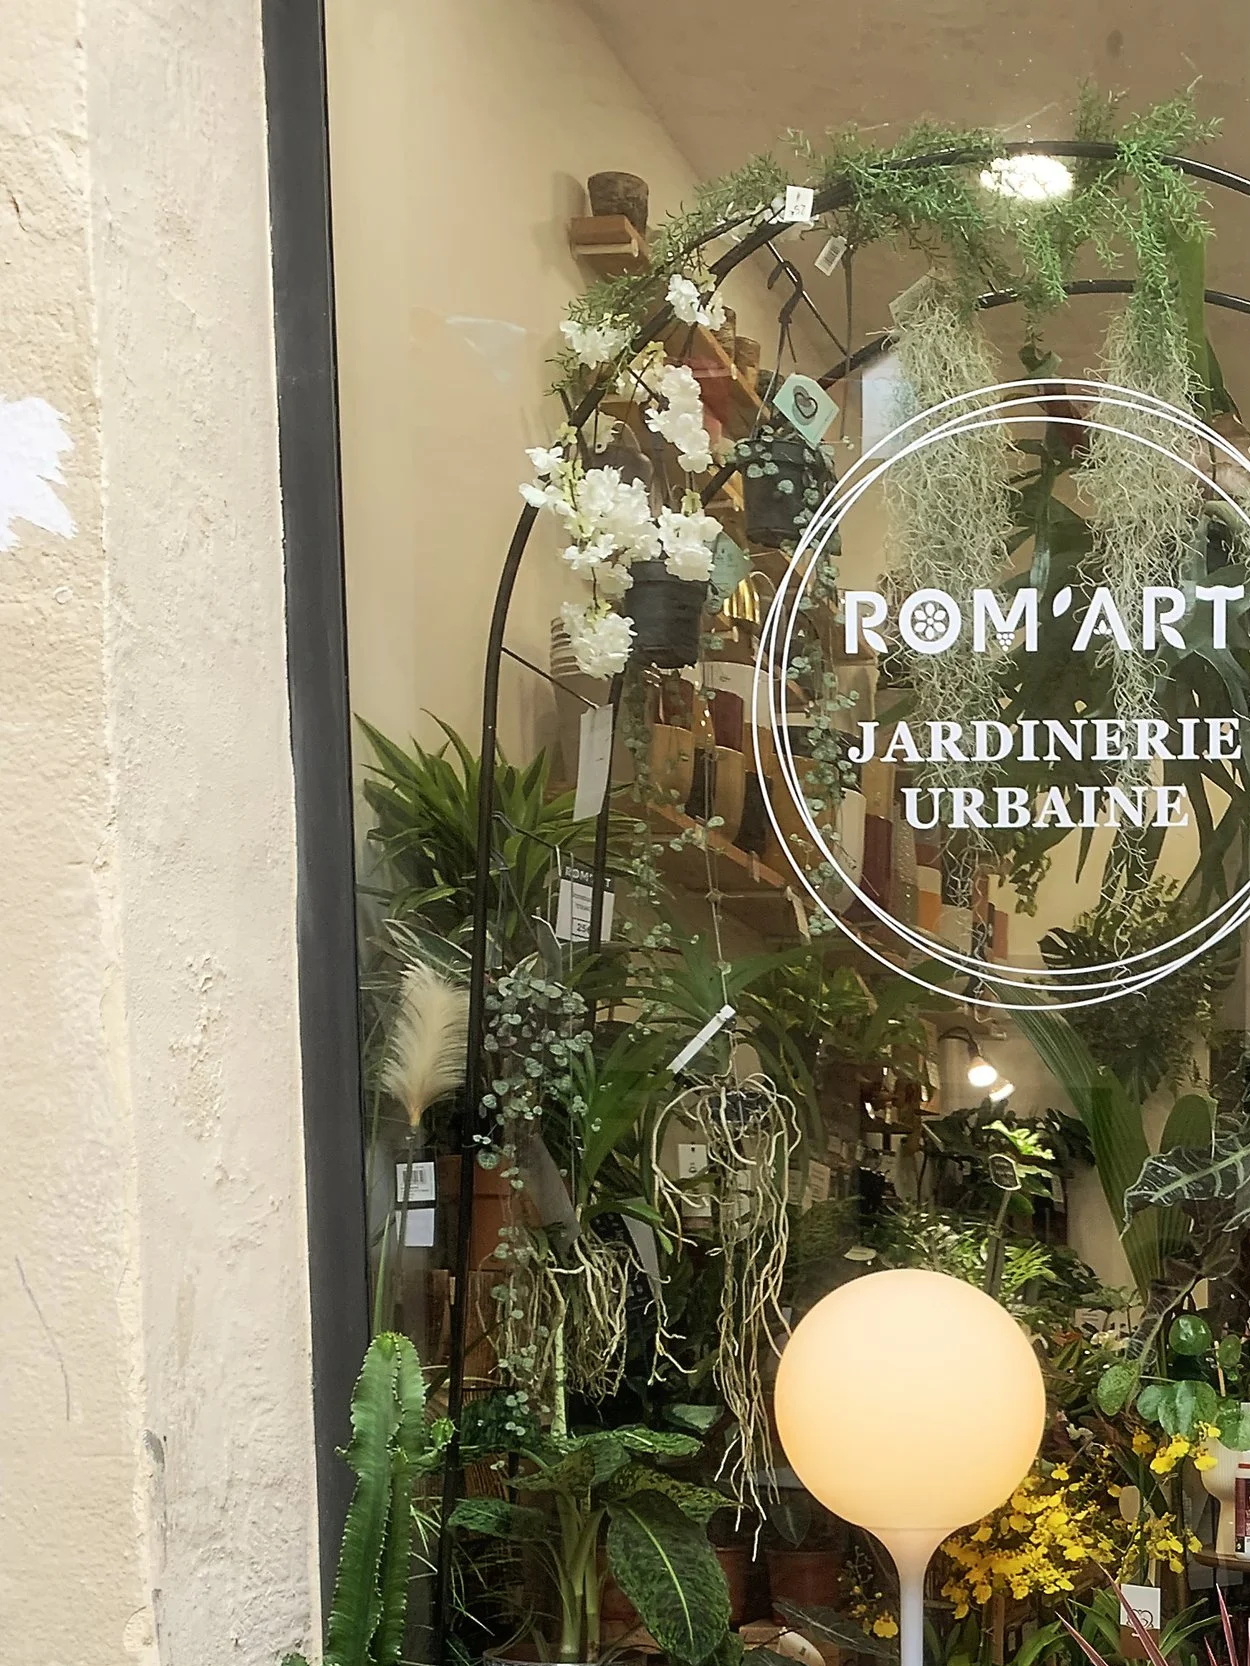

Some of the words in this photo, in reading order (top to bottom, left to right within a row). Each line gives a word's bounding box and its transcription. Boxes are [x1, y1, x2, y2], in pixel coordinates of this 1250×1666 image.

[843, 584, 1245, 654] ROM'ART
[847, 717, 1242, 764] JARDINERIE
[900, 784, 1189, 830] URBAINE
